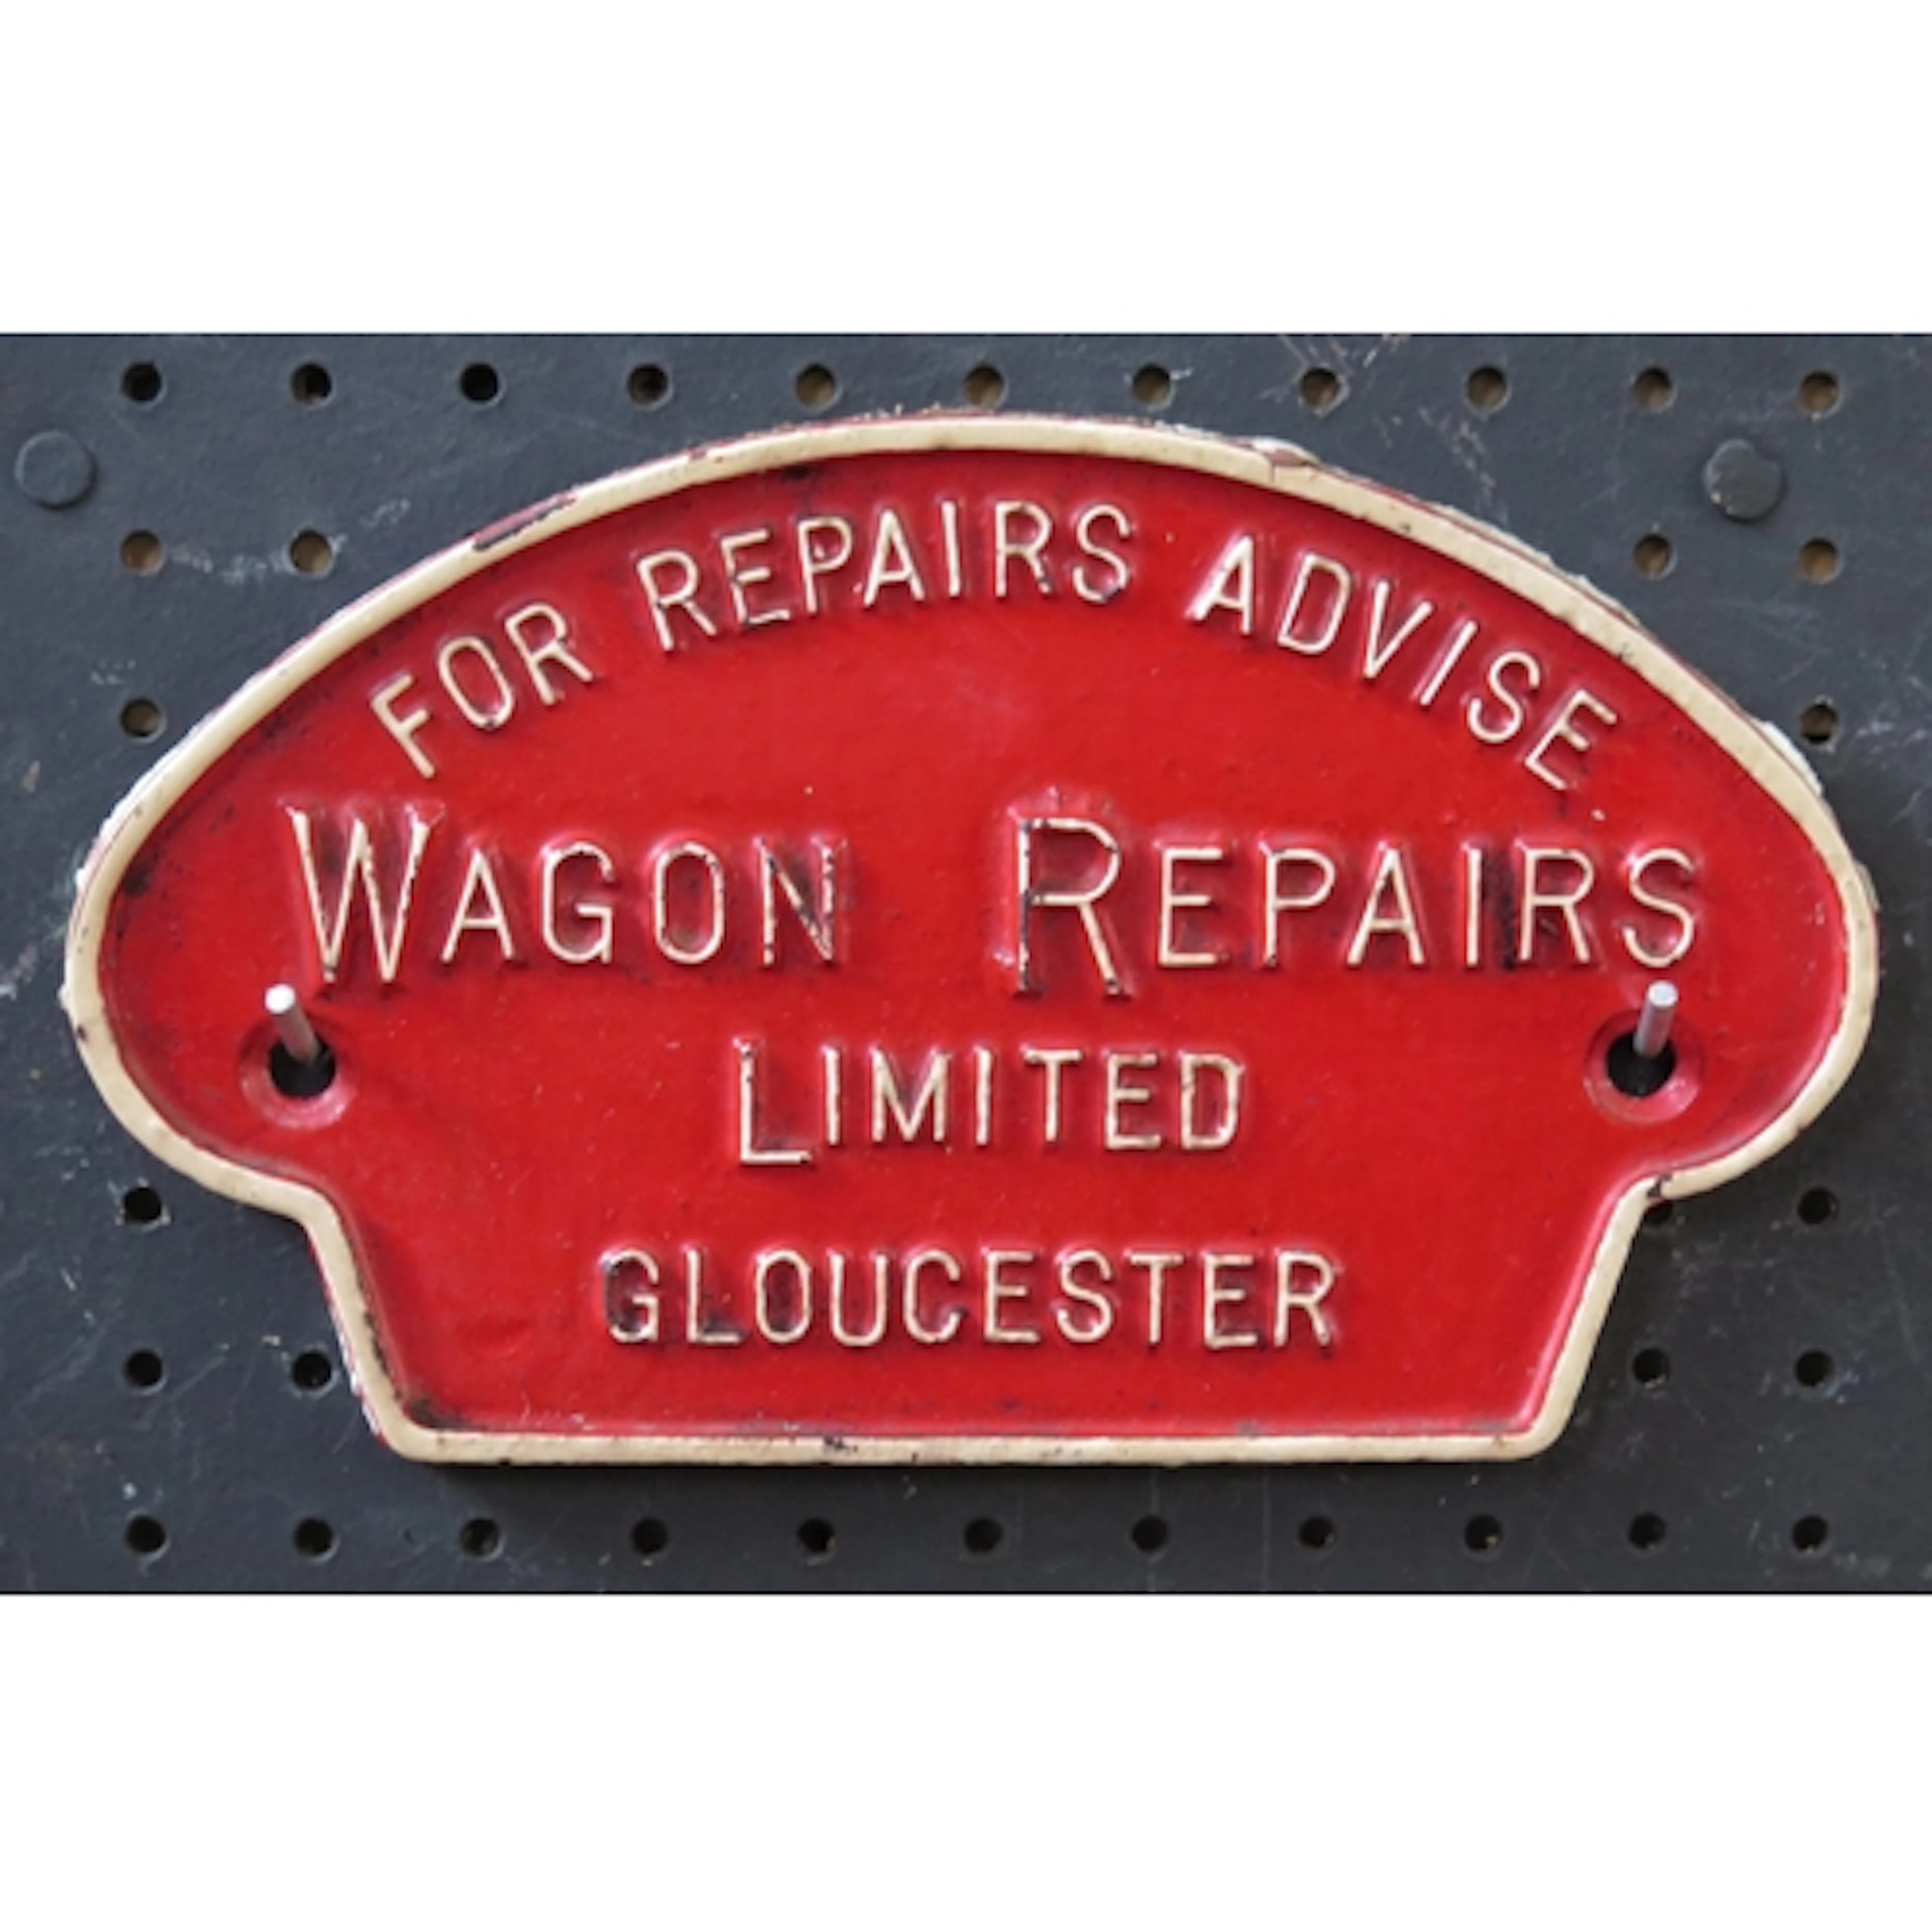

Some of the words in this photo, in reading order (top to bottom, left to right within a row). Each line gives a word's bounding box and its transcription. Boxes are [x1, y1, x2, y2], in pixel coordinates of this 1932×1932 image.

[371, 605, 594, 778] FOR
[635, 502, 1133, 651] REPAIRS
[1187, 535, 1617, 790] ADVISE
[287, 805, 842, 984] WAGON
[1012, 817, 1699, 996] REPAIRS
[736, 1041, 1242, 1166] LIMITED
[604, 1248, 1339, 1347] GLOUCESTER
